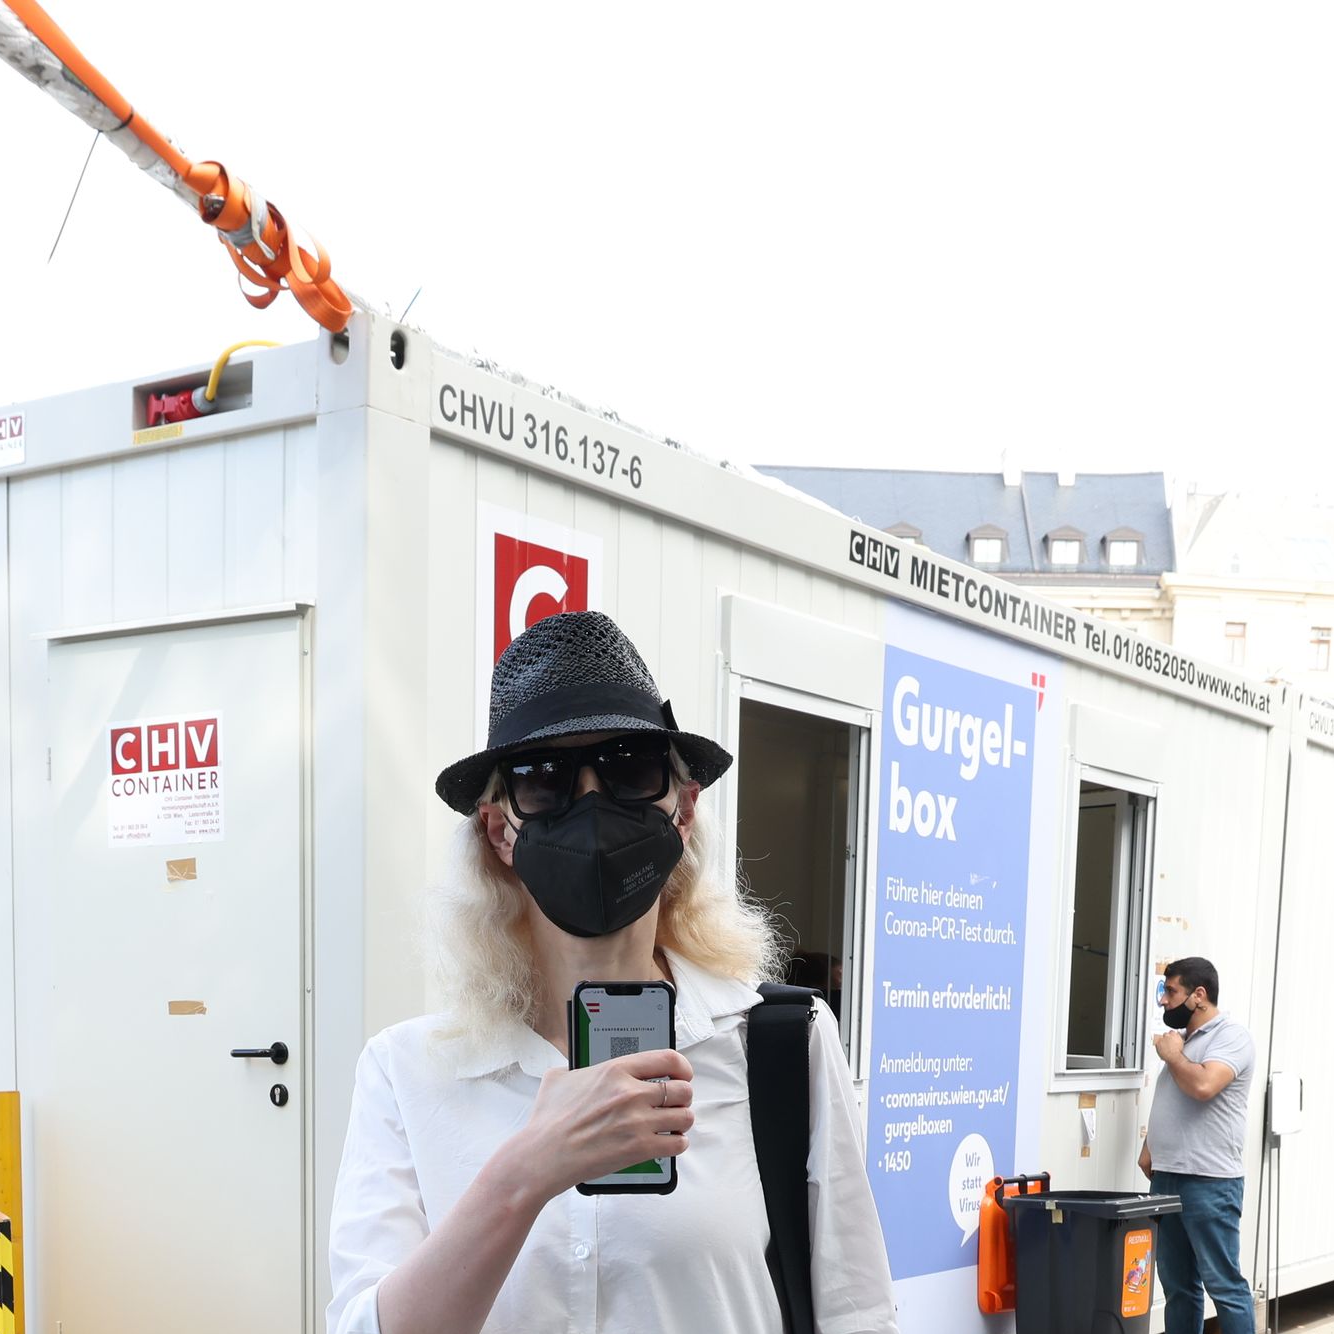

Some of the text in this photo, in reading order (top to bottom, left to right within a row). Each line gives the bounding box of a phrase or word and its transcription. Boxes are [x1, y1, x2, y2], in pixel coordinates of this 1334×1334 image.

[439, 384, 642, 489] CHVU 316.137-6
[850, 531, 1271, 714] CHV MIETCONTAINER Tel. 01/8652050 www.chv.at
[892, 675, 1027, 781] Gurgel-
[113, 722, 216, 771] CHV
[112, 771, 219, 797] CONTAINER
[889, 760, 958, 841] box
[886, 876, 983, 910] Führe hier deinen
[884, 911, 1017, 945] Corona-PCR-Test durch.
[882, 981, 1011, 1011] Termin erforderlich!
[880, 1052, 973, 1078] Anmeldung unter:
[886, 1081, 1010, 1110] coronavirus.wien.gv.at/
[884, 1114, 953, 1144] gurgelboxen
[884, 1151, 911, 1173] 1450
[965, 1152, 981, 1168] Wir
[962, 1176, 982, 1191] statt
